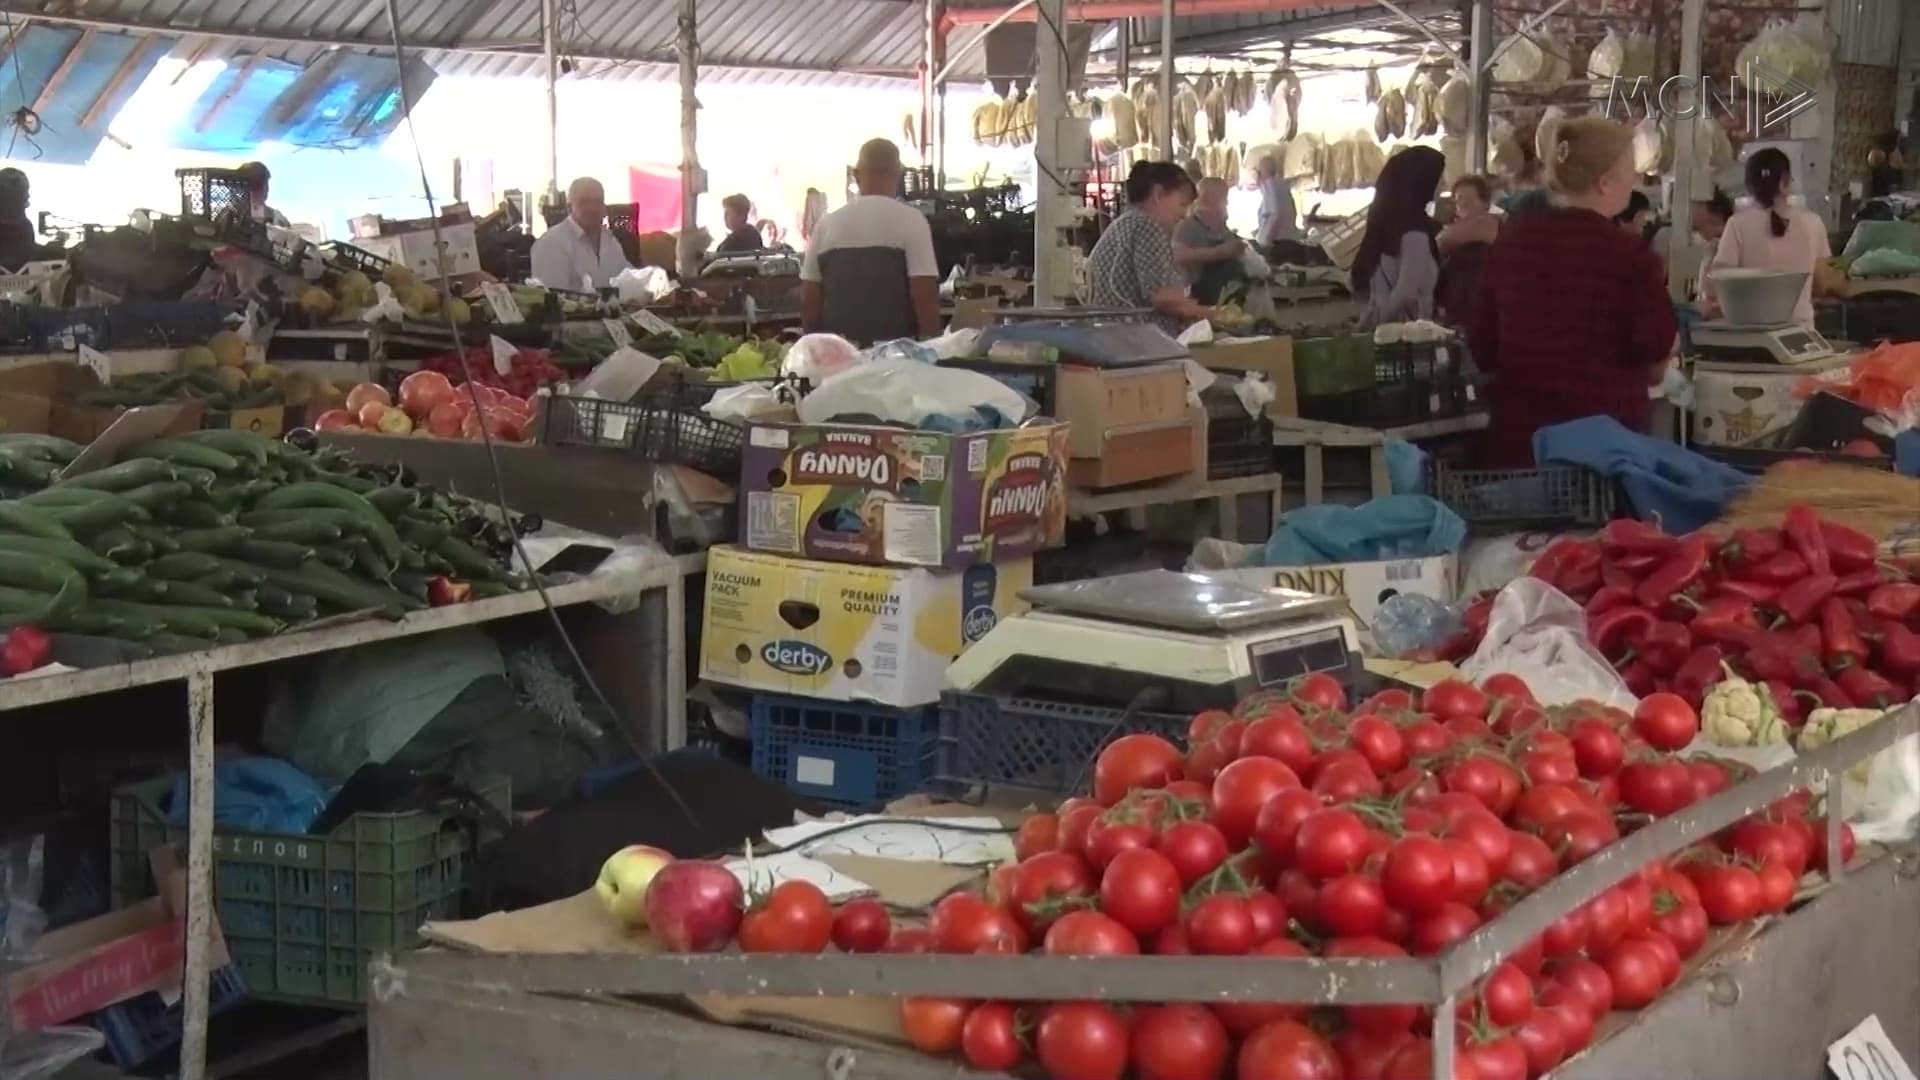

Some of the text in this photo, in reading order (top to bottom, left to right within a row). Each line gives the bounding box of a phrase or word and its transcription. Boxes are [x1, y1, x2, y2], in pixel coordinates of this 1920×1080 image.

[825, 432, 872, 447] BANANA
[712, 570, 761, 588] VACUUM
[711, 582, 740, 597] PACK
[840, 588, 900, 605] PREMIUM
[843, 601, 899, 617] QUALITY
[965, 608, 995, 636] derby
[764, 640, 829, 674] derby
